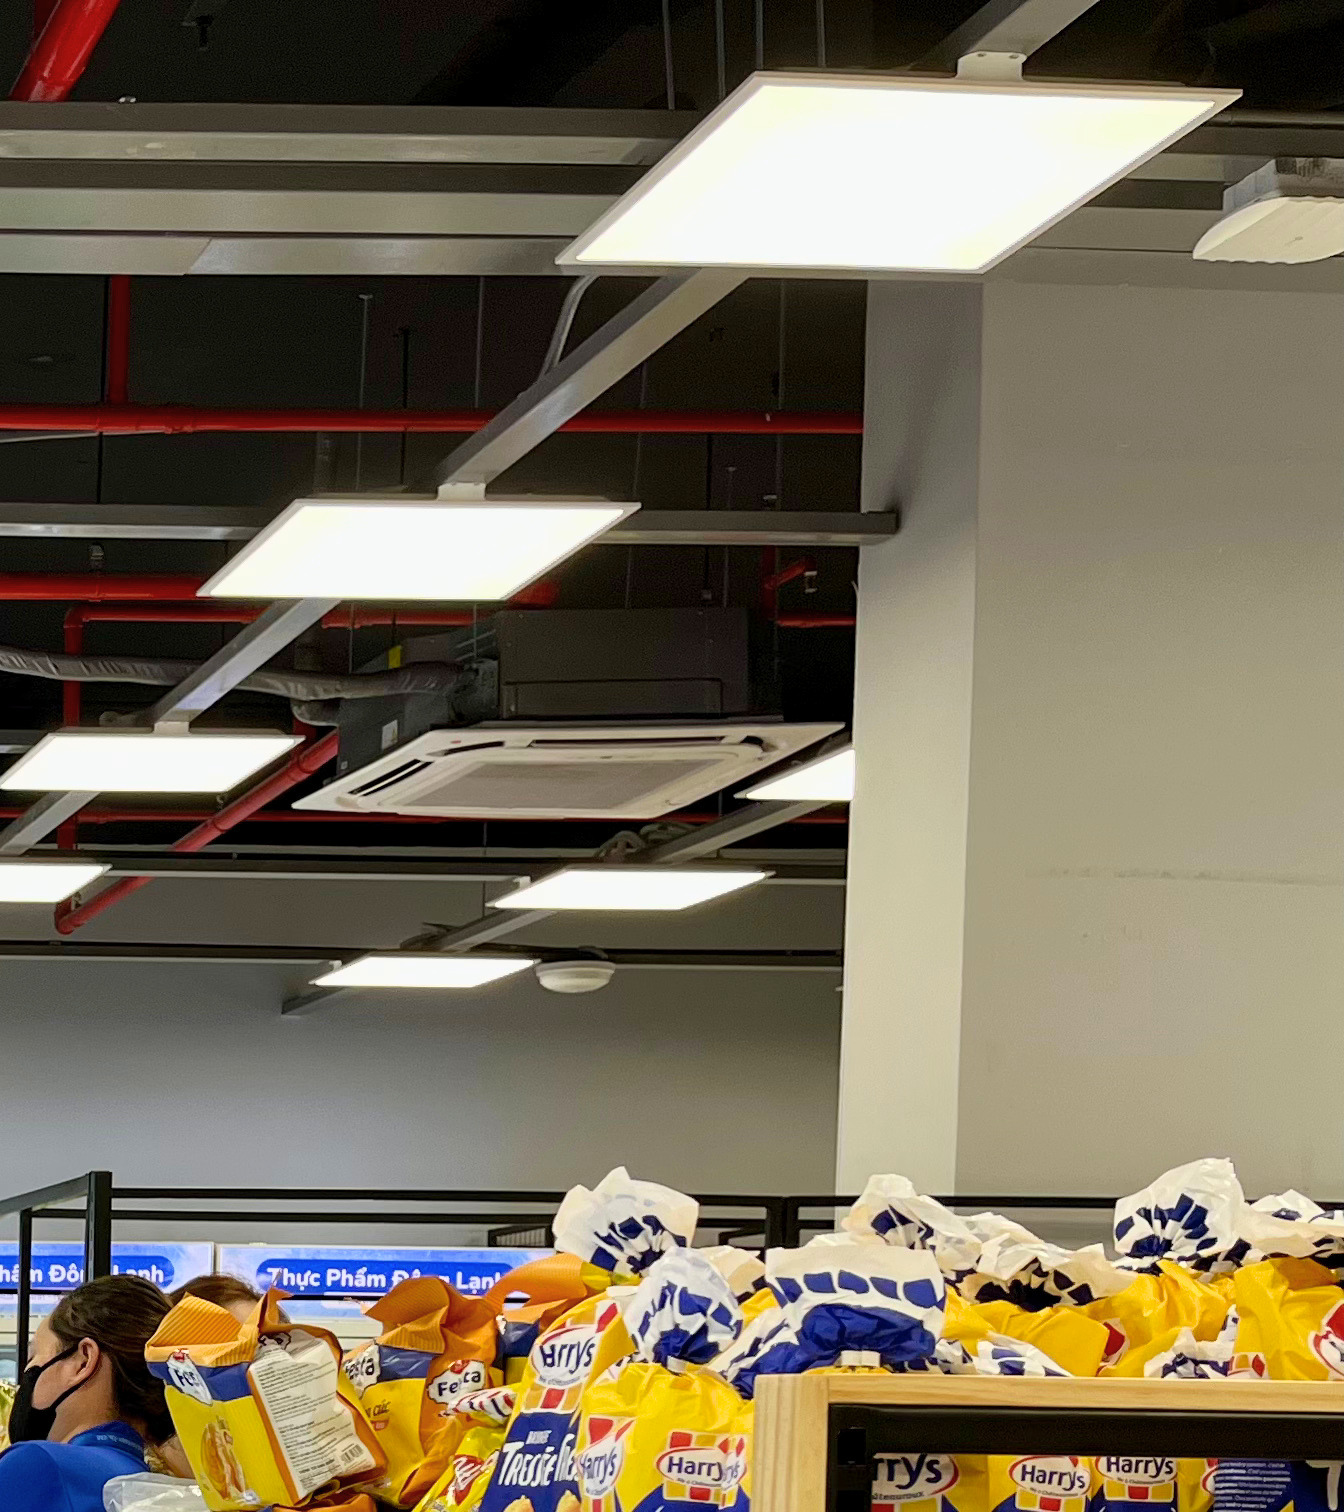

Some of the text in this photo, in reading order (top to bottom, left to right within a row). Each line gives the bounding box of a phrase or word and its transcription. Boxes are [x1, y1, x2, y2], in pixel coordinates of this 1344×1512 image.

[267, 1267, 321, 1290] Thực
[326, 1266, 386, 1289] Phẩm
[873, 1454, 943, 1490] rrys
[1020, 1465, 1085, 1491] Harrys
[1106, 1457, 1174, 1476] Harrys
